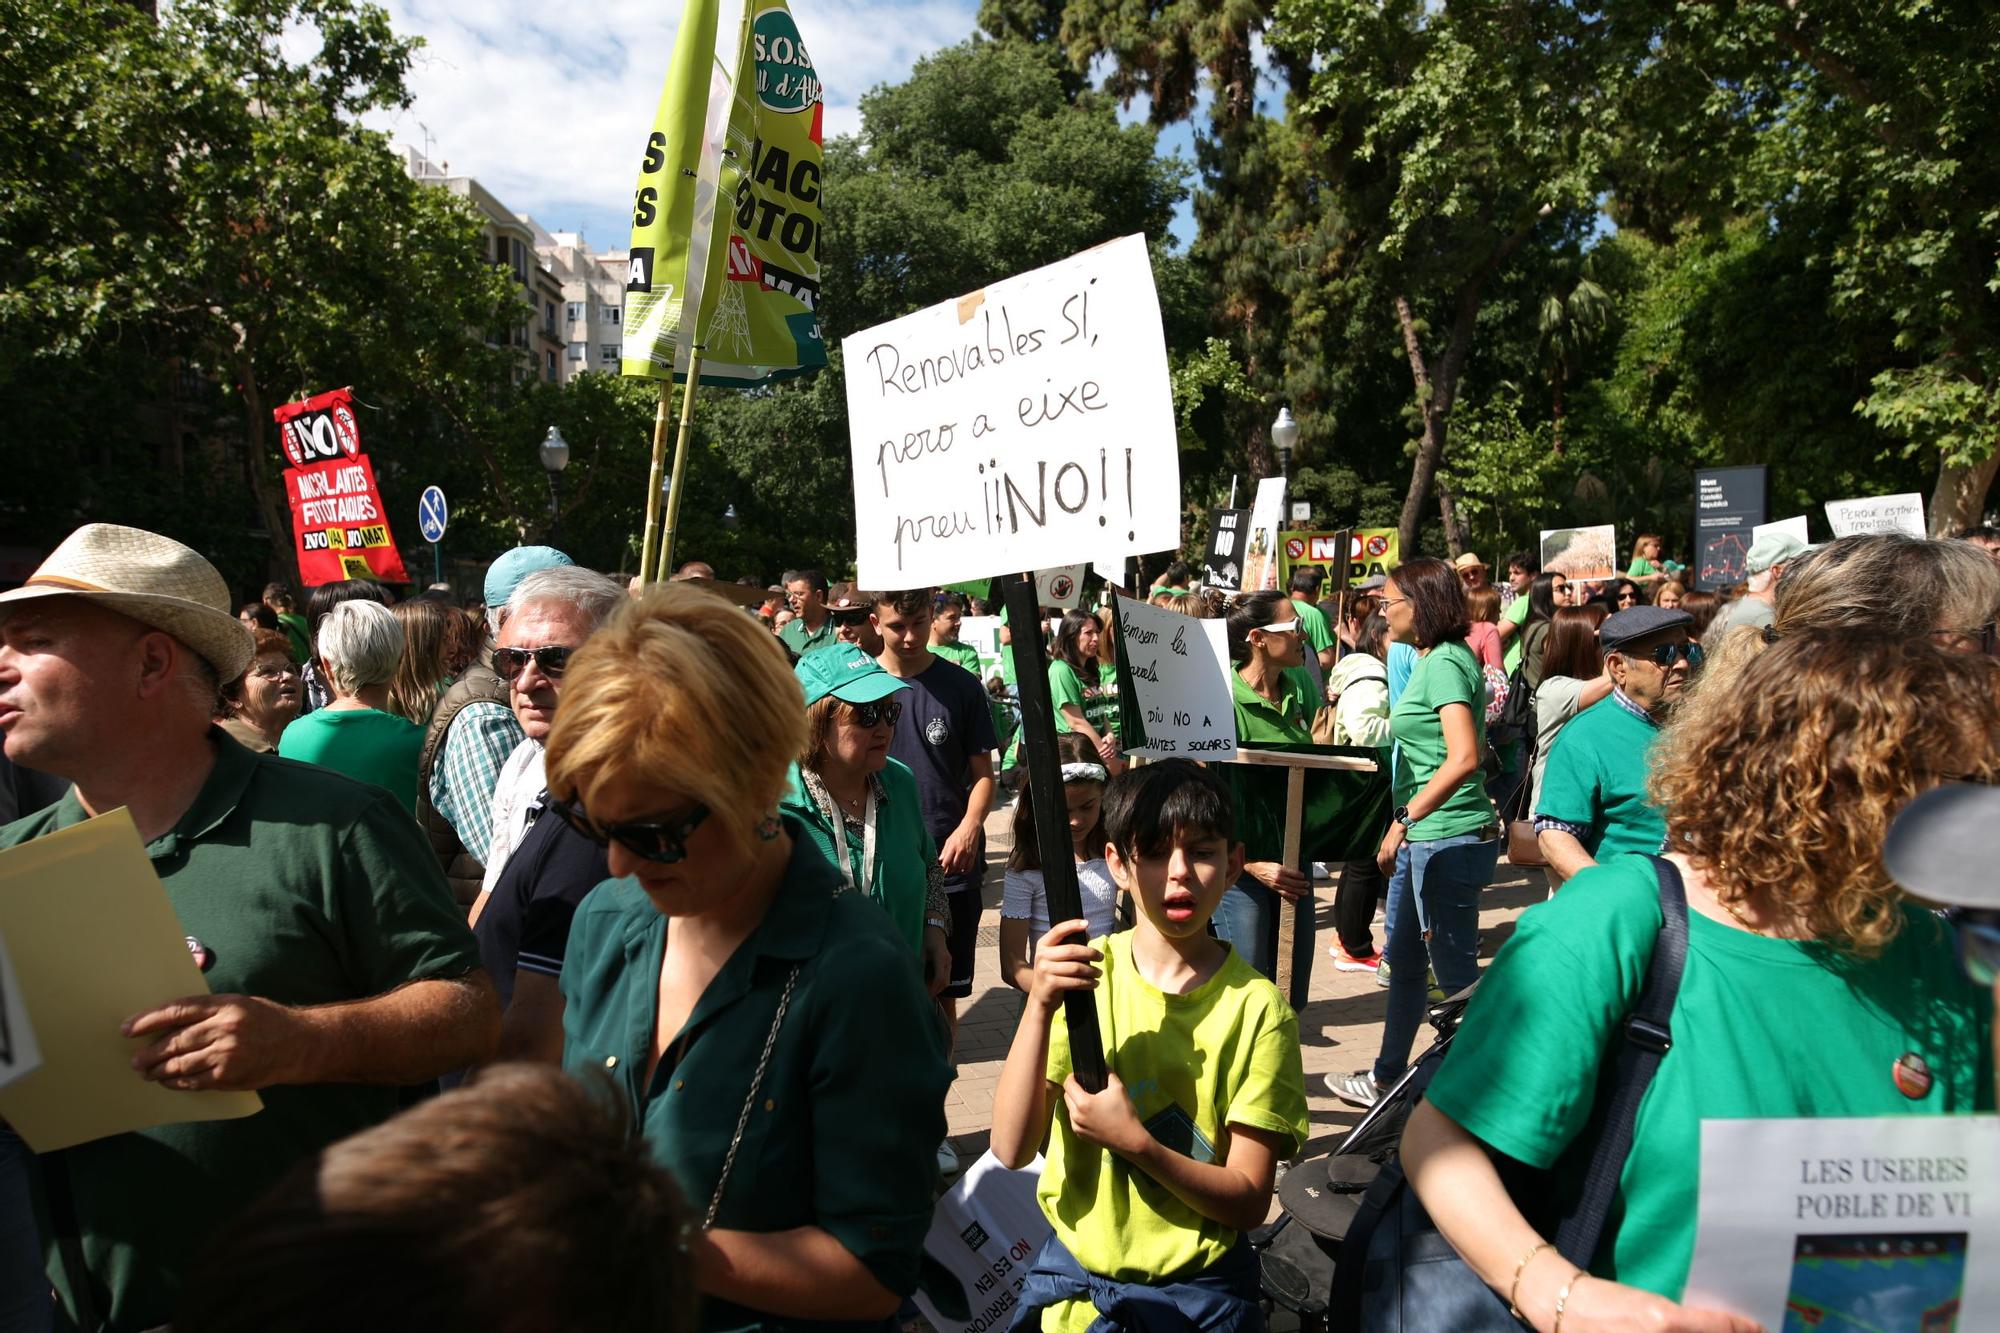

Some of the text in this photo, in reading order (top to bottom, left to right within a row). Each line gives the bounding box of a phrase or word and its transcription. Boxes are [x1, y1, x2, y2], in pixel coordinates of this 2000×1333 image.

[751, 136, 822, 209] AC
[736, 177, 822, 261] OTO
[867, 306, 1046, 397] Renovables
[294, 413, 339, 460] NO
[877, 379, 1108, 498] pero a eixe
[304, 530, 328, 549] NO
[347, 530, 362, 547] NO
[363, 526, 386, 546] MAT
[894, 512, 976, 571] preu
[1214, 531, 1235, 556] NO
[1289, 562, 1387, 579] ADA
[1171, 625, 1188, 656] les
[1173, 711, 1191, 727] NO
[1203, 716, 1212, 727] A
[1188, 739, 1231, 752] SOLARS
[1800, 1157, 1969, 1184] LES USERES
[1796, 1195, 1888, 1219] POBLE
[1896, 1193, 1935, 1218] DE
[1010, 1238, 1032, 1261] NO
[993, 1256, 1013, 1277] ES
